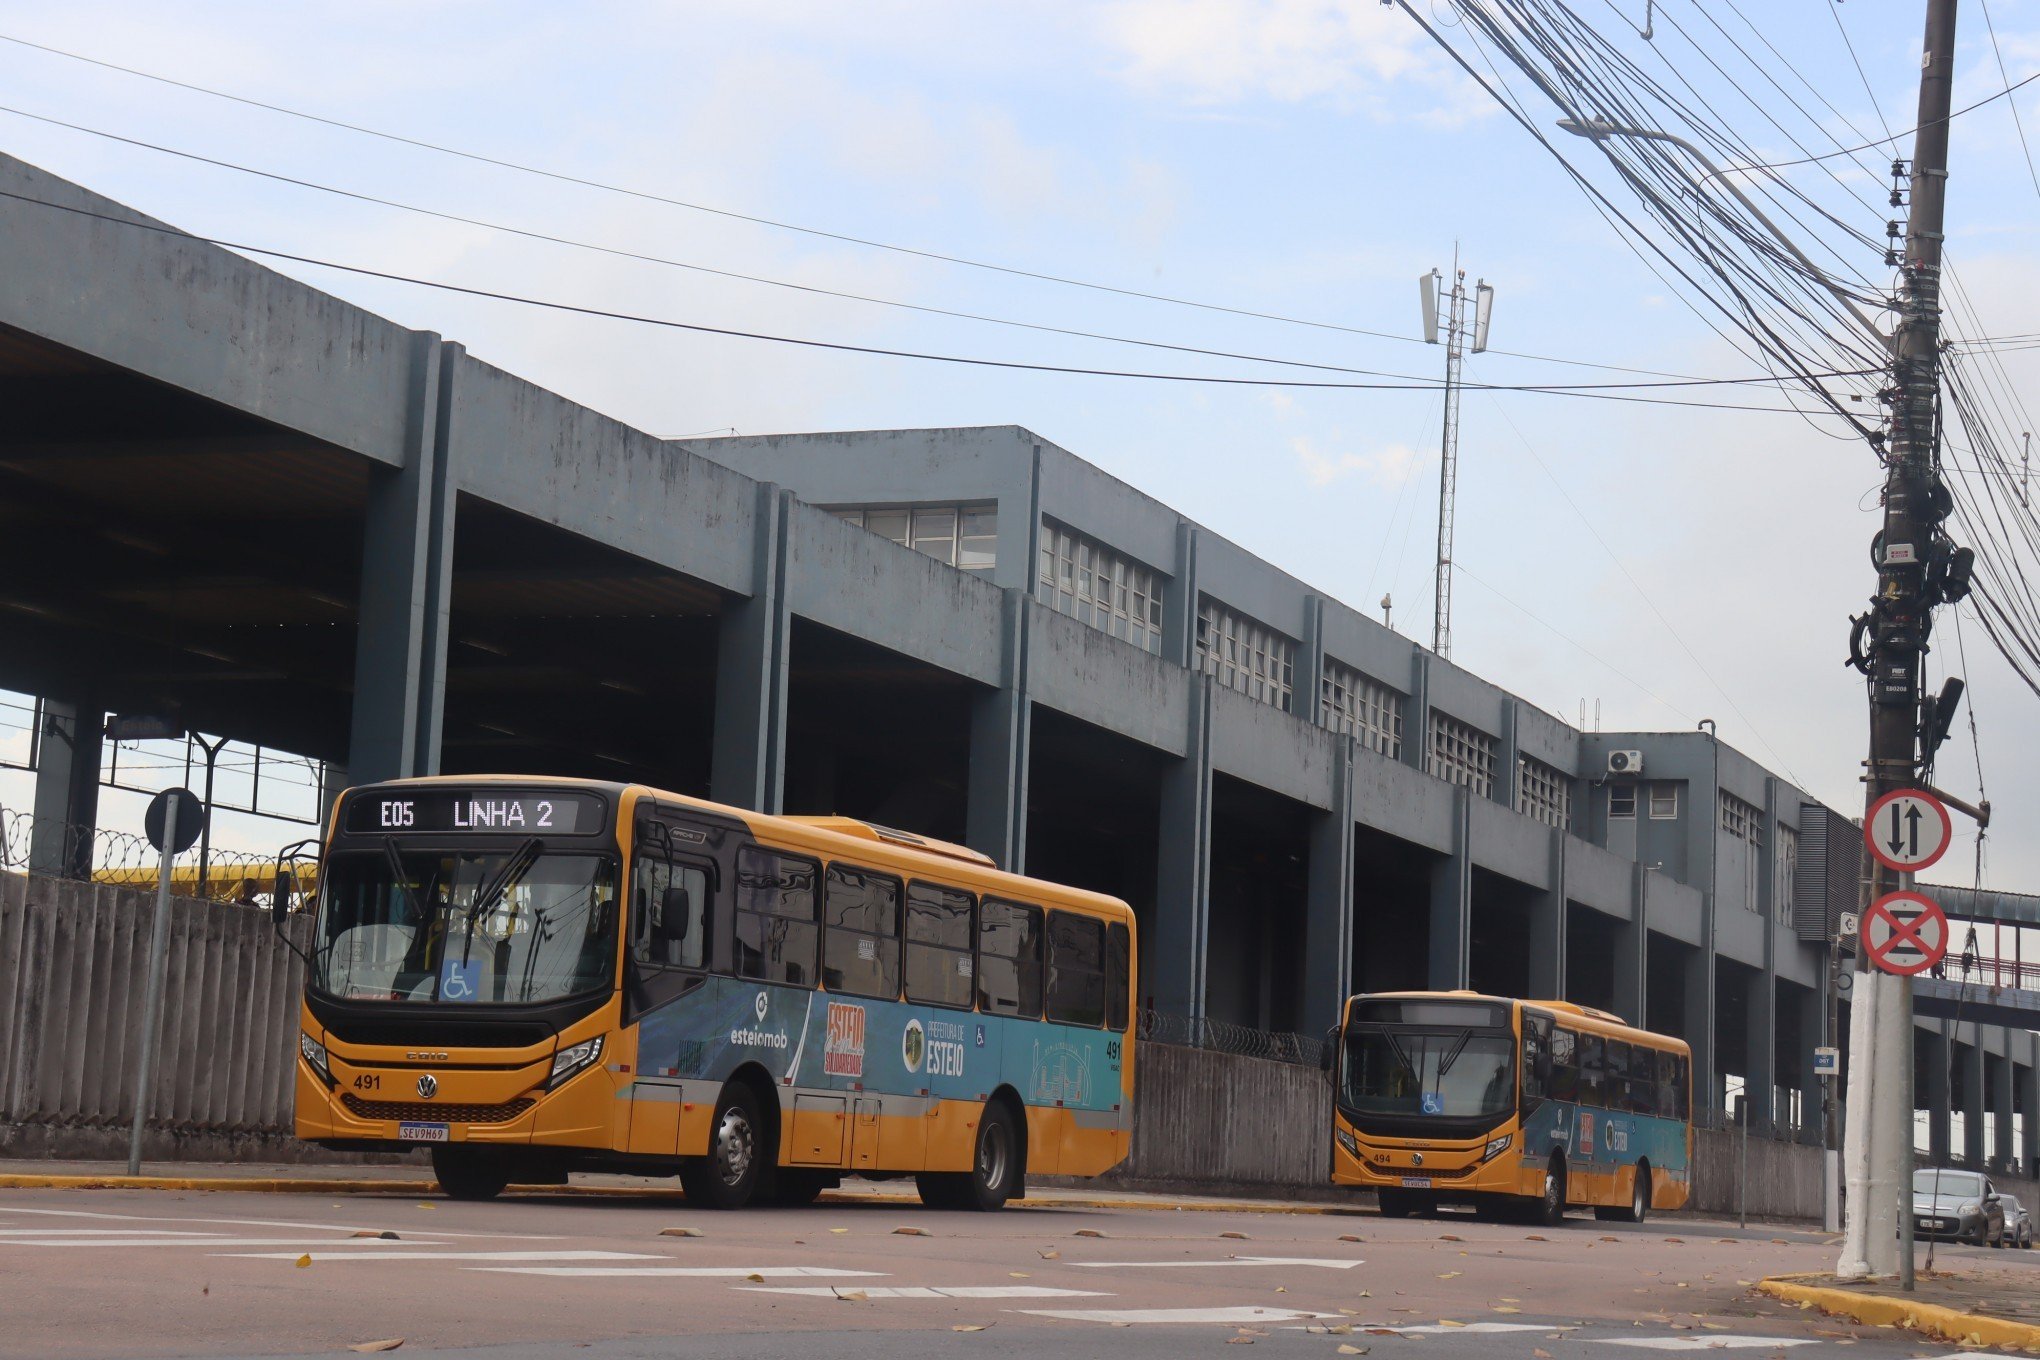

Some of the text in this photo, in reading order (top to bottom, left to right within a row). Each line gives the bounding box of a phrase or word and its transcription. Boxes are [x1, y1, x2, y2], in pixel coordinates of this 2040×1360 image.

[381, 801, 414, 827] E05
[454, 801, 553, 827] LINHA 2
[731, 1025, 788, 1049] esteiomob
[928, 1021, 965, 1042] PREFEITURA DE
[926, 1040, 964, 1077] ESTEIO
[1107, 1040, 1121, 1060] 491
[353, 1075, 380, 1090] 491
[403, 1128, 443, 1139] SEV9H69
[1373, 1154, 1391, 1164] 494
